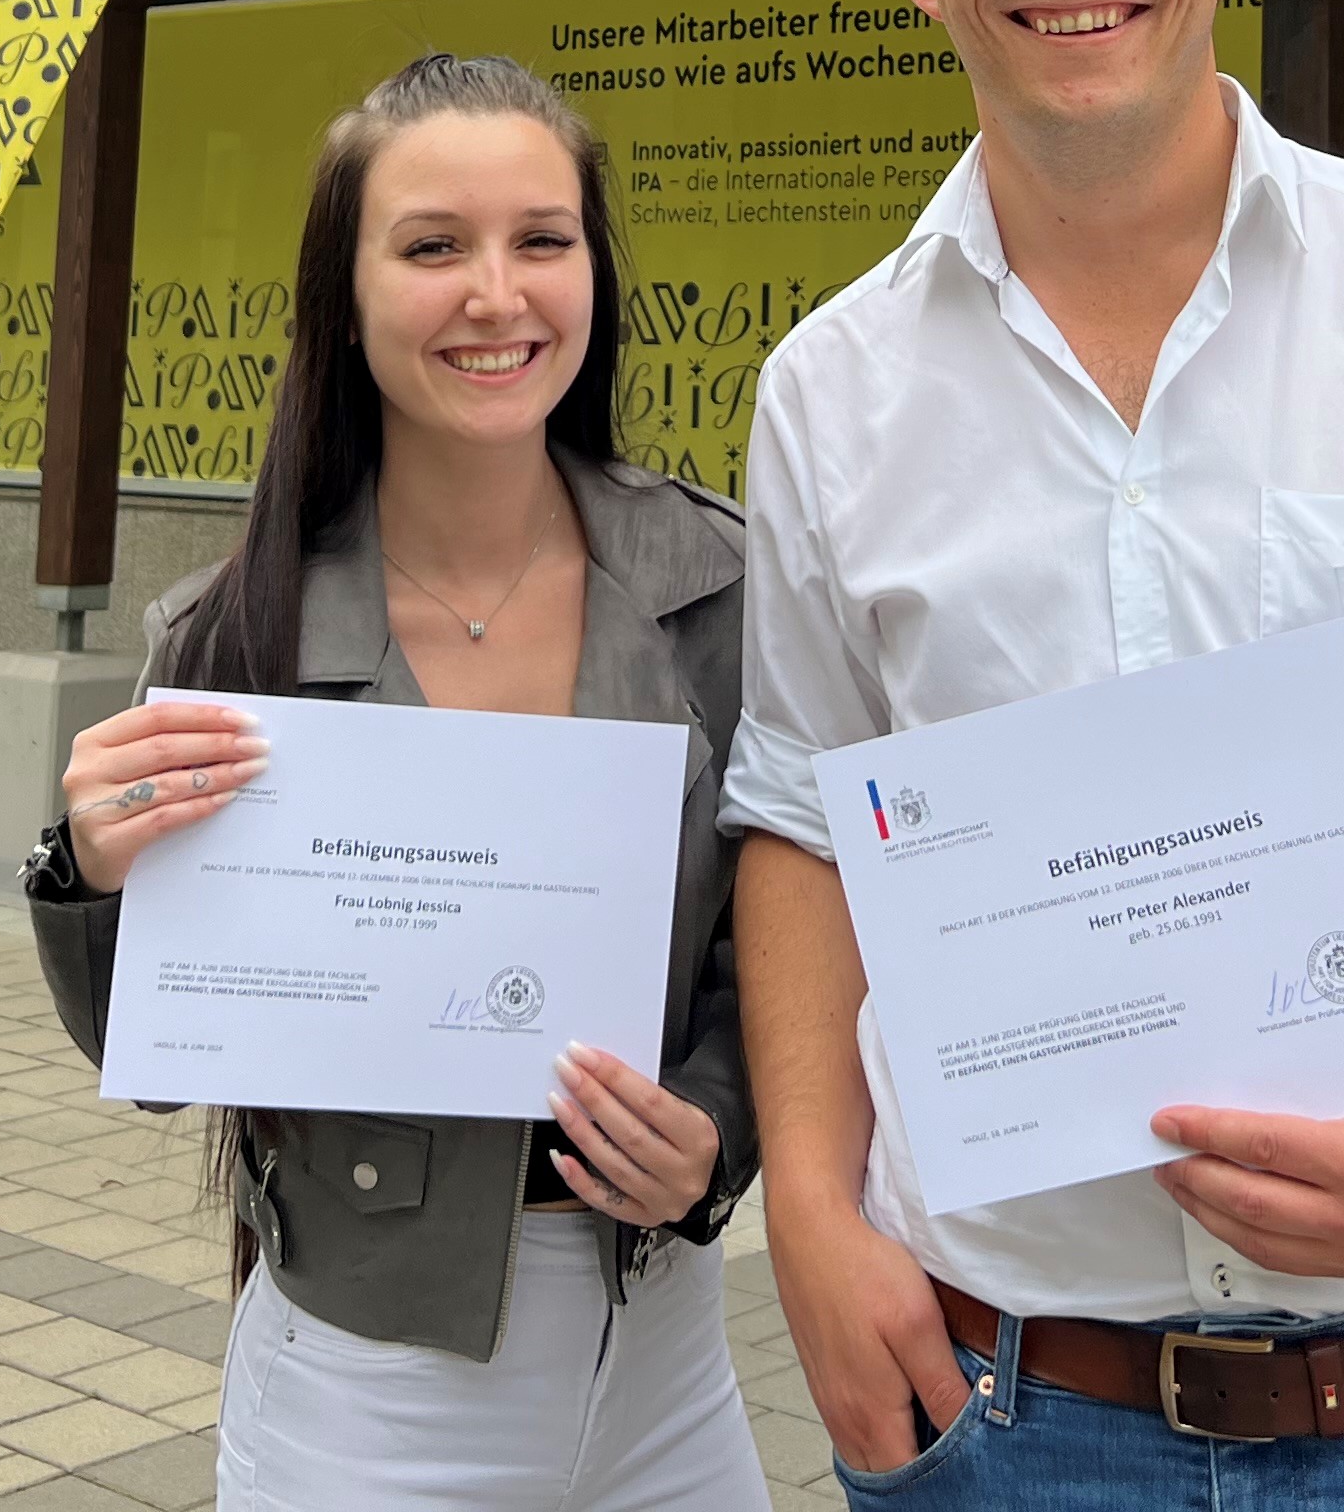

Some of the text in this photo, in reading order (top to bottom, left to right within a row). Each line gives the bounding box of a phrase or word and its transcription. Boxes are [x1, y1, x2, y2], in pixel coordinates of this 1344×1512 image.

[552, 1, 930, 51] Unsere Mitarbeiter freuen
[551, 66, 665, 96] genauso
[676, 54, 725, 87] wie
[736, 49, 796, 84] aufs
[632, 141, 732, 162] Innovativ,
[740, 134, 861, 162] passioniert
[869, 129, 913, 154] und
[632, 173, 662, 192] IPA
[688, 168, 717, 191] die
[726, 163, 874, 190] Internationale
[631, 191, 921, 226] Schweiz, Liechtenstein und
[311, 837, 499, 869] Befähigungsausweis
[1047, 808, 1264, 878] Befähigungsausweis
[334, 894, 461, 913] Frau Lobnig Jessica
[1087, 877, 1252, 930] Herr Peter Alexander
[354, 915, 437, 930] geb. 03.07.1999
[1127, 909, 1222, 945] geb. 25.06.1991
